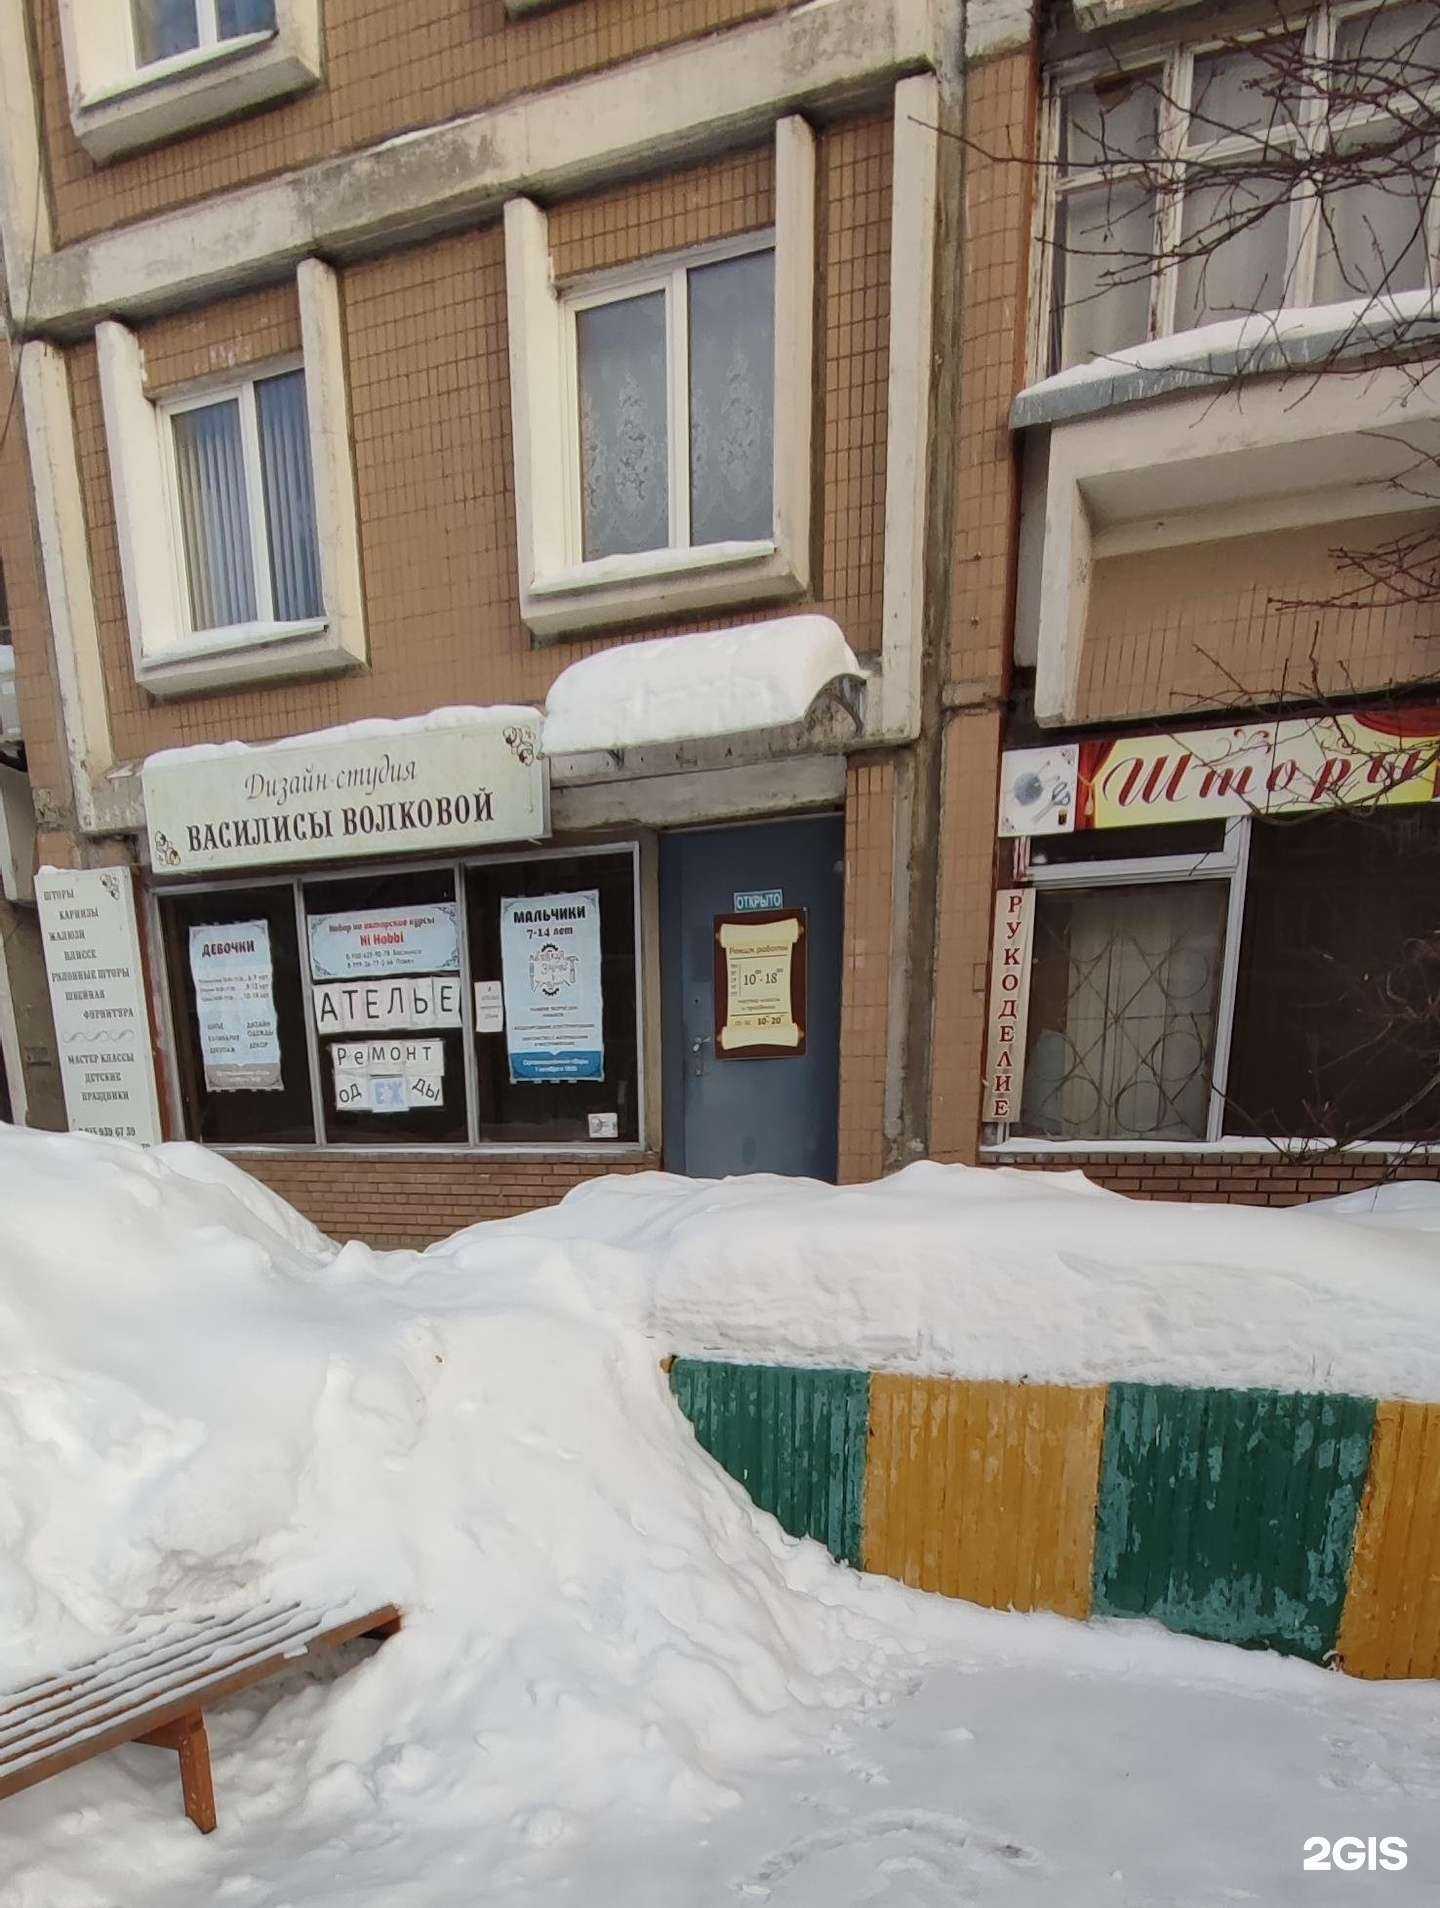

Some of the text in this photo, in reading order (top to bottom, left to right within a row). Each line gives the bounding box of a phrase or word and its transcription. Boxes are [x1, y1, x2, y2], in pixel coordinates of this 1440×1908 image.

[245, 754, 419, 805] Дизайн-студия
[1101, 750, 1419, 807] Шторы
[186, 787, 496, 852] ВАСИЛИСЫ ВОЛКОВОЙ
[44, 889, 74, 901] ШТОРЫ
[737, 894, 781, 909] ОТКРЫТО
[513, 906, 586, 923] МАЛЬЧИКИ
[527, 928, 550, 939] 7-14
[202, 940, 255, 957] ДЕВОЧКИ
[98, 967, 130, 979] ШТОРЫ
[320, 985, 453, 1022] АТЕЛЬЕ
[993, 895, 1023, 1117] РУКОДЕЛИЕ
[67, 1052, 134, 1065] МАСТЕР КЛАССЫ
